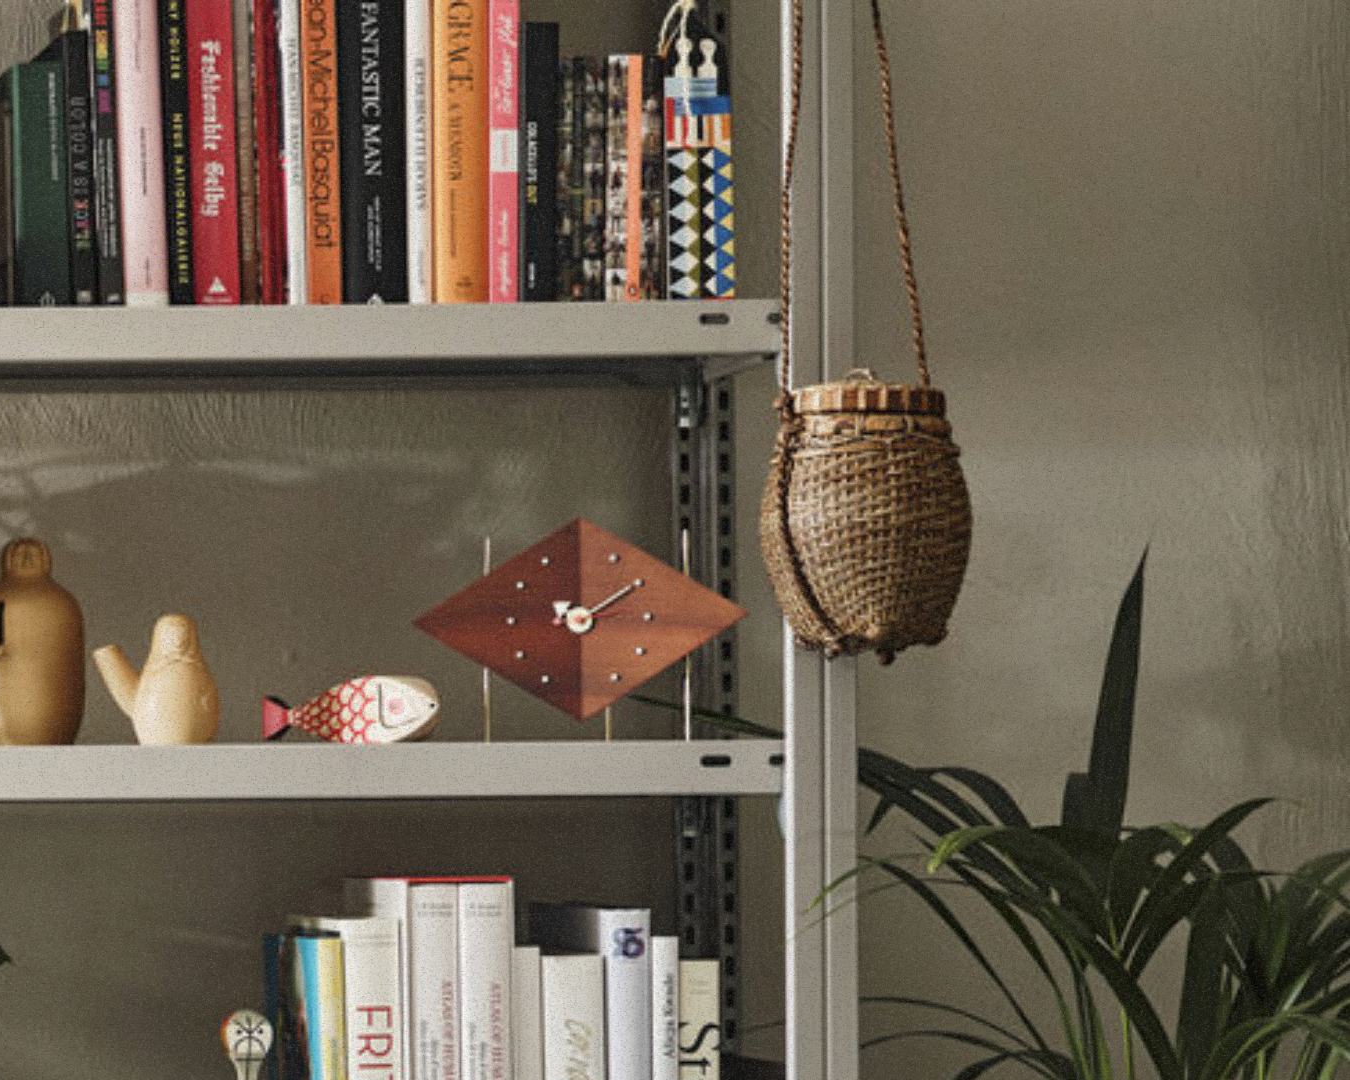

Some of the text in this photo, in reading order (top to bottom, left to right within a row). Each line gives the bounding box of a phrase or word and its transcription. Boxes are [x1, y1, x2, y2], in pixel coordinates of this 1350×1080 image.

[361, 2, 383, 177] FANTASTIC MAN
[448, 0, 475, 93] GRACE
